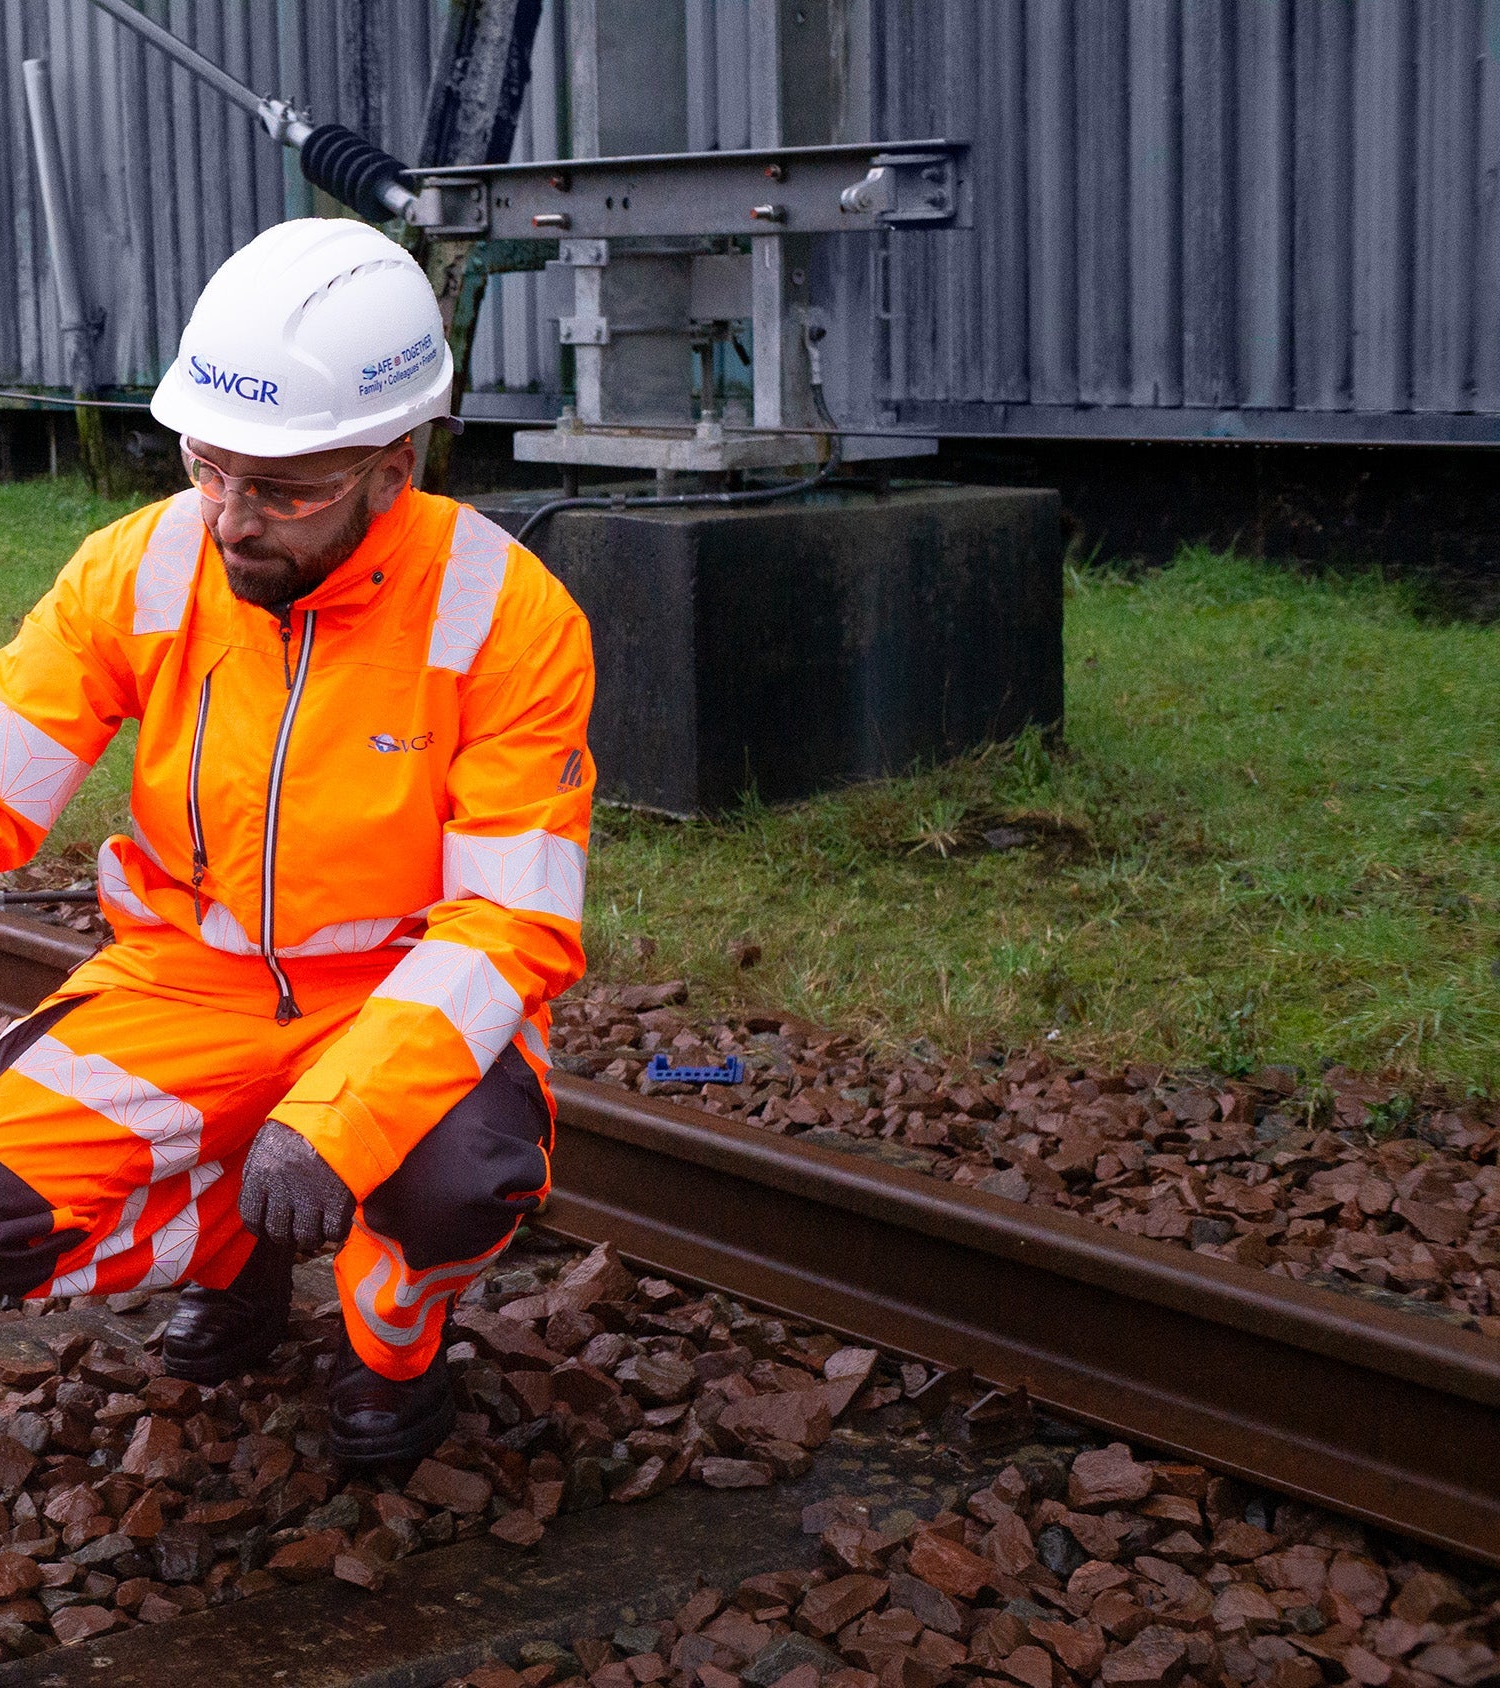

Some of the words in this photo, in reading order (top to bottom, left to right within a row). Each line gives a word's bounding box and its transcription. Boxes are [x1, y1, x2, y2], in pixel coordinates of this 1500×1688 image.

[362, 357, 393, 380] SAFE
[401, 333, 433, 363] TOGETHER
[189, 355, 280, 406] SWGR
[358, 379, 383, 396] Family
